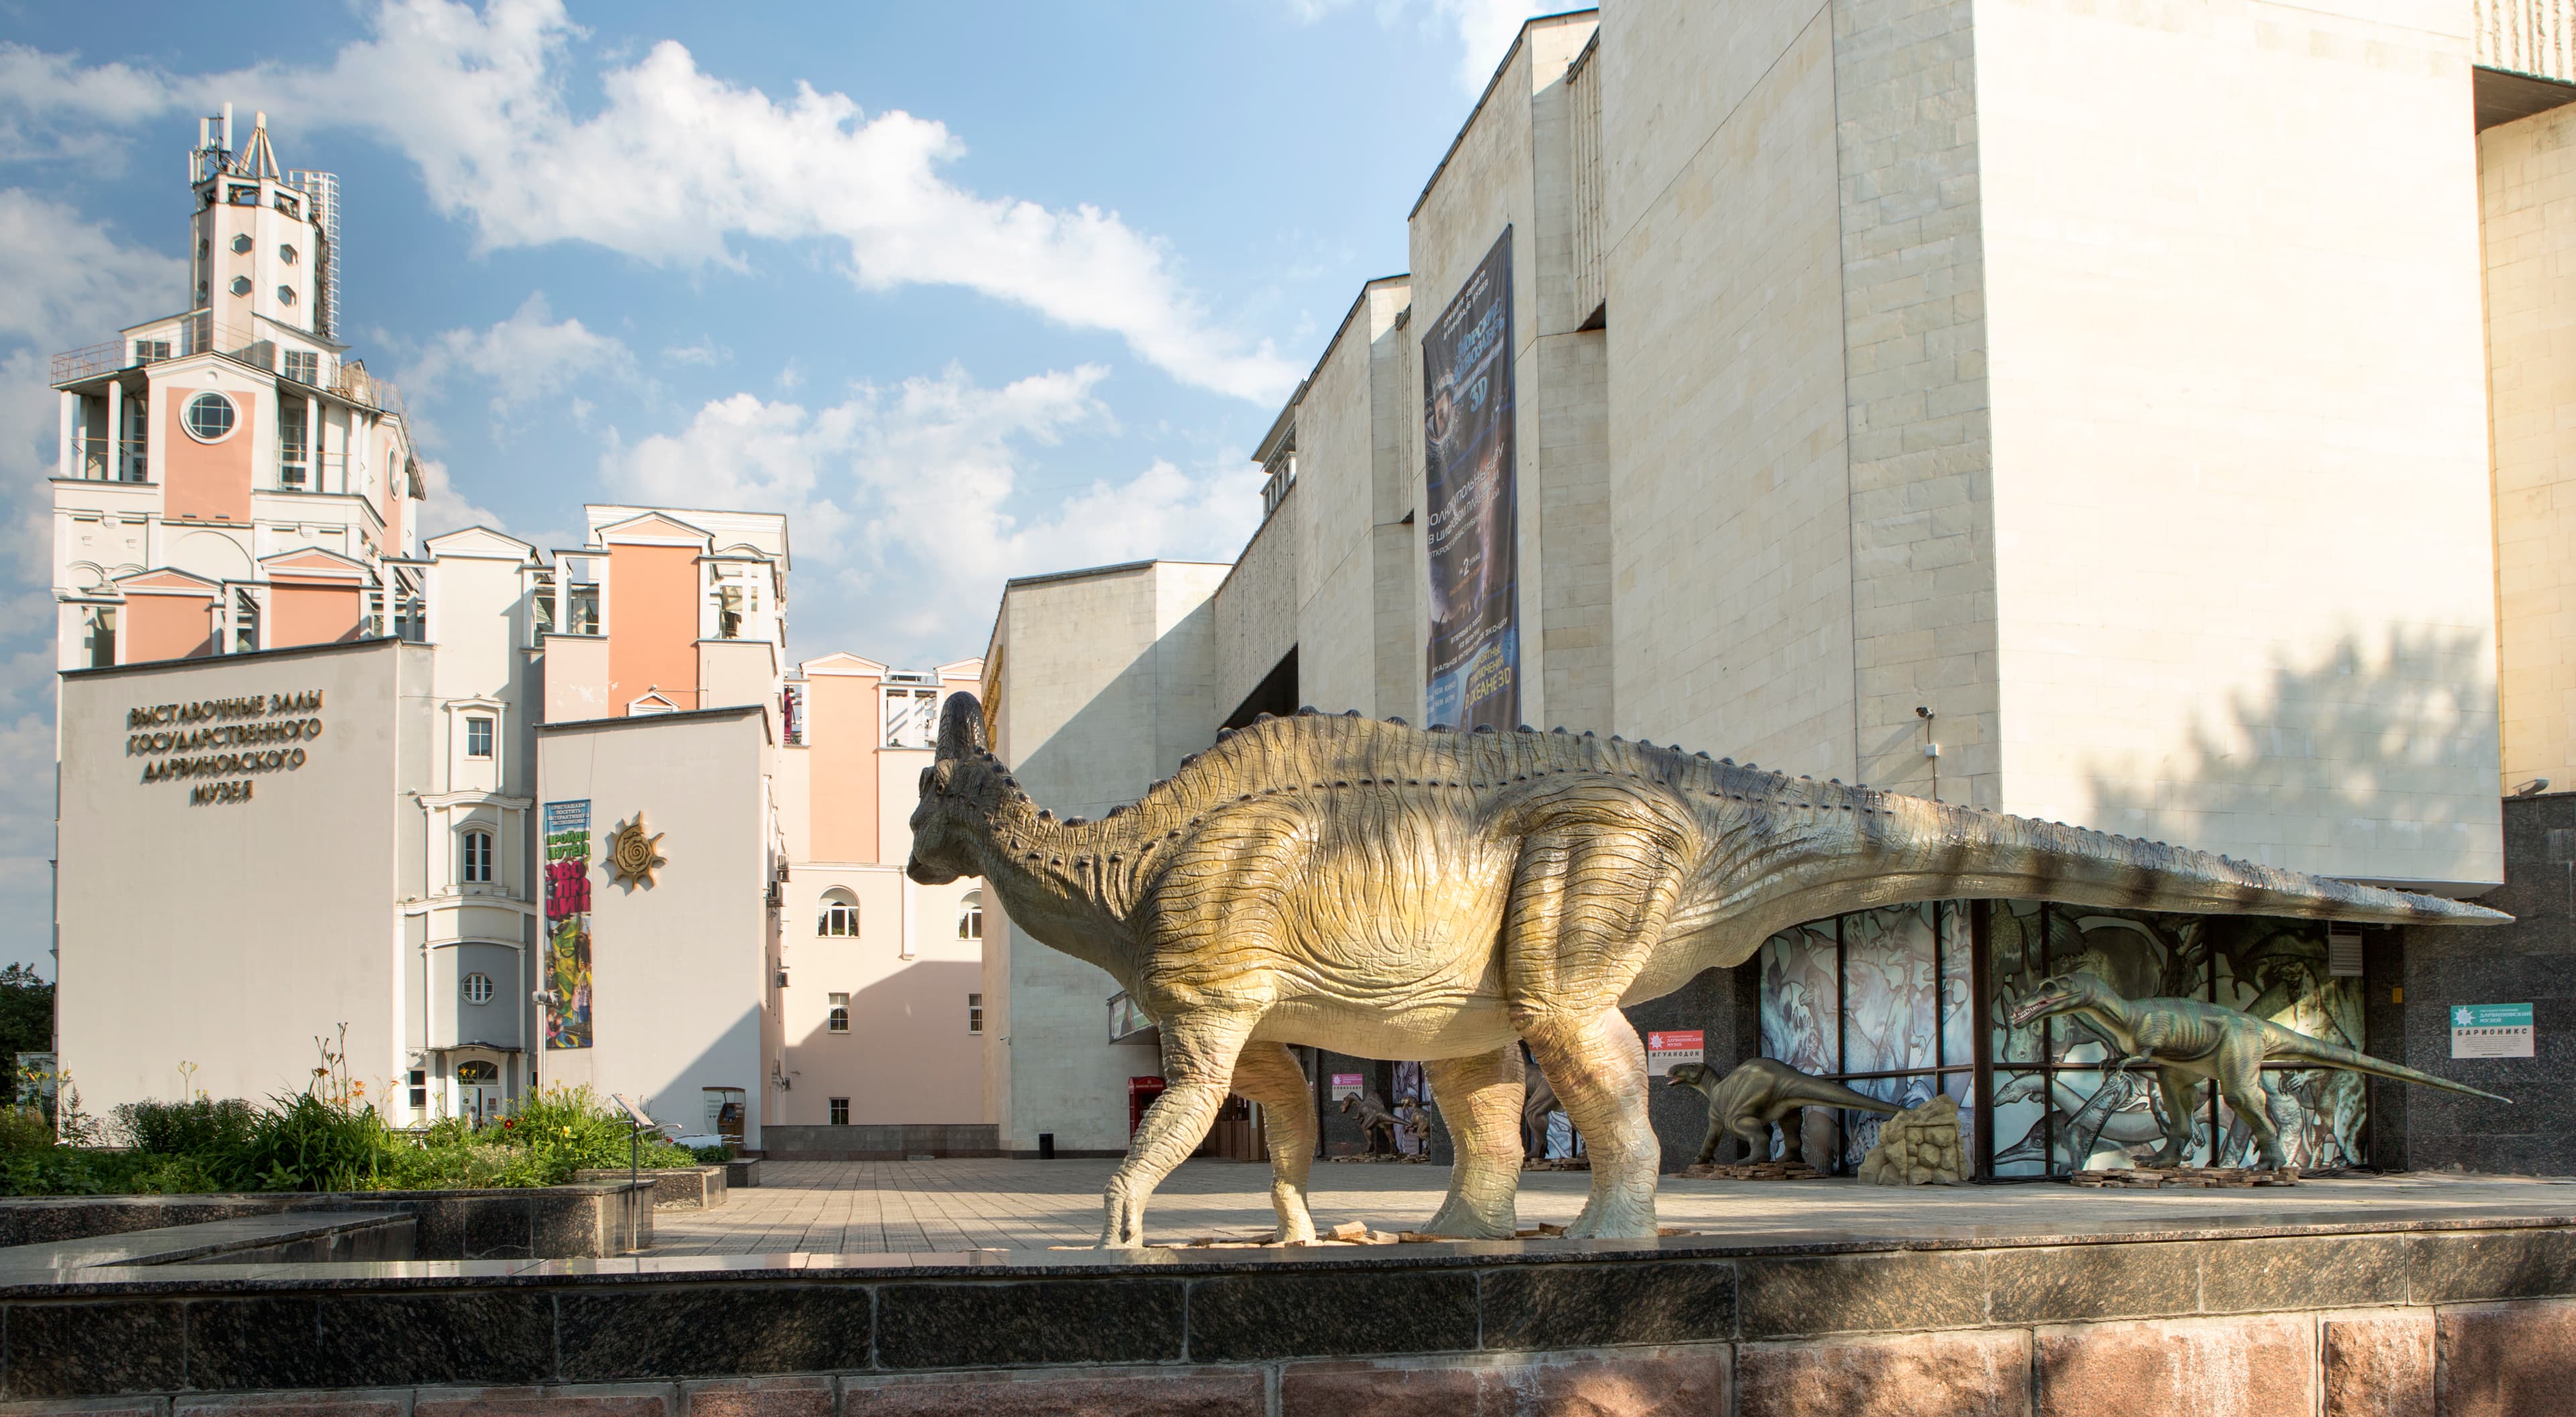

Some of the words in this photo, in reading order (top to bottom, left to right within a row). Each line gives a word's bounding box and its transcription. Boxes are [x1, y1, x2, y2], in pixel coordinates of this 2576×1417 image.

[1470, 376, 1488, 412] 3D
[1429, 533, 1434, 545] В
[1463, 557, 1470, 577] 2
[1464, 693, 1470, 710] В
[1498, 667, 1511, 687] 3D
[130, 695, 266, 727] ВЫСТАВОЧНЫЕ
[271, 689, 323, 713] ЗАЛЫ
[130, 718, 323, 752] ГОСУДАРСТВЕННОГО
[144, 747, 307, 780] ДАРВИНОВСКОГО
[193, 780, 254, 802] МУЗЕЯ
[547, 830, 590, 846] ПРОЙДИ
[546, 860, 584, 881] ЭВО
[554, 876, 590, 897] ЛЮ
[547, 894, 590, 920] ЦИИ
[2457, 1028, 2528, 1036] БАРИОНИКС
